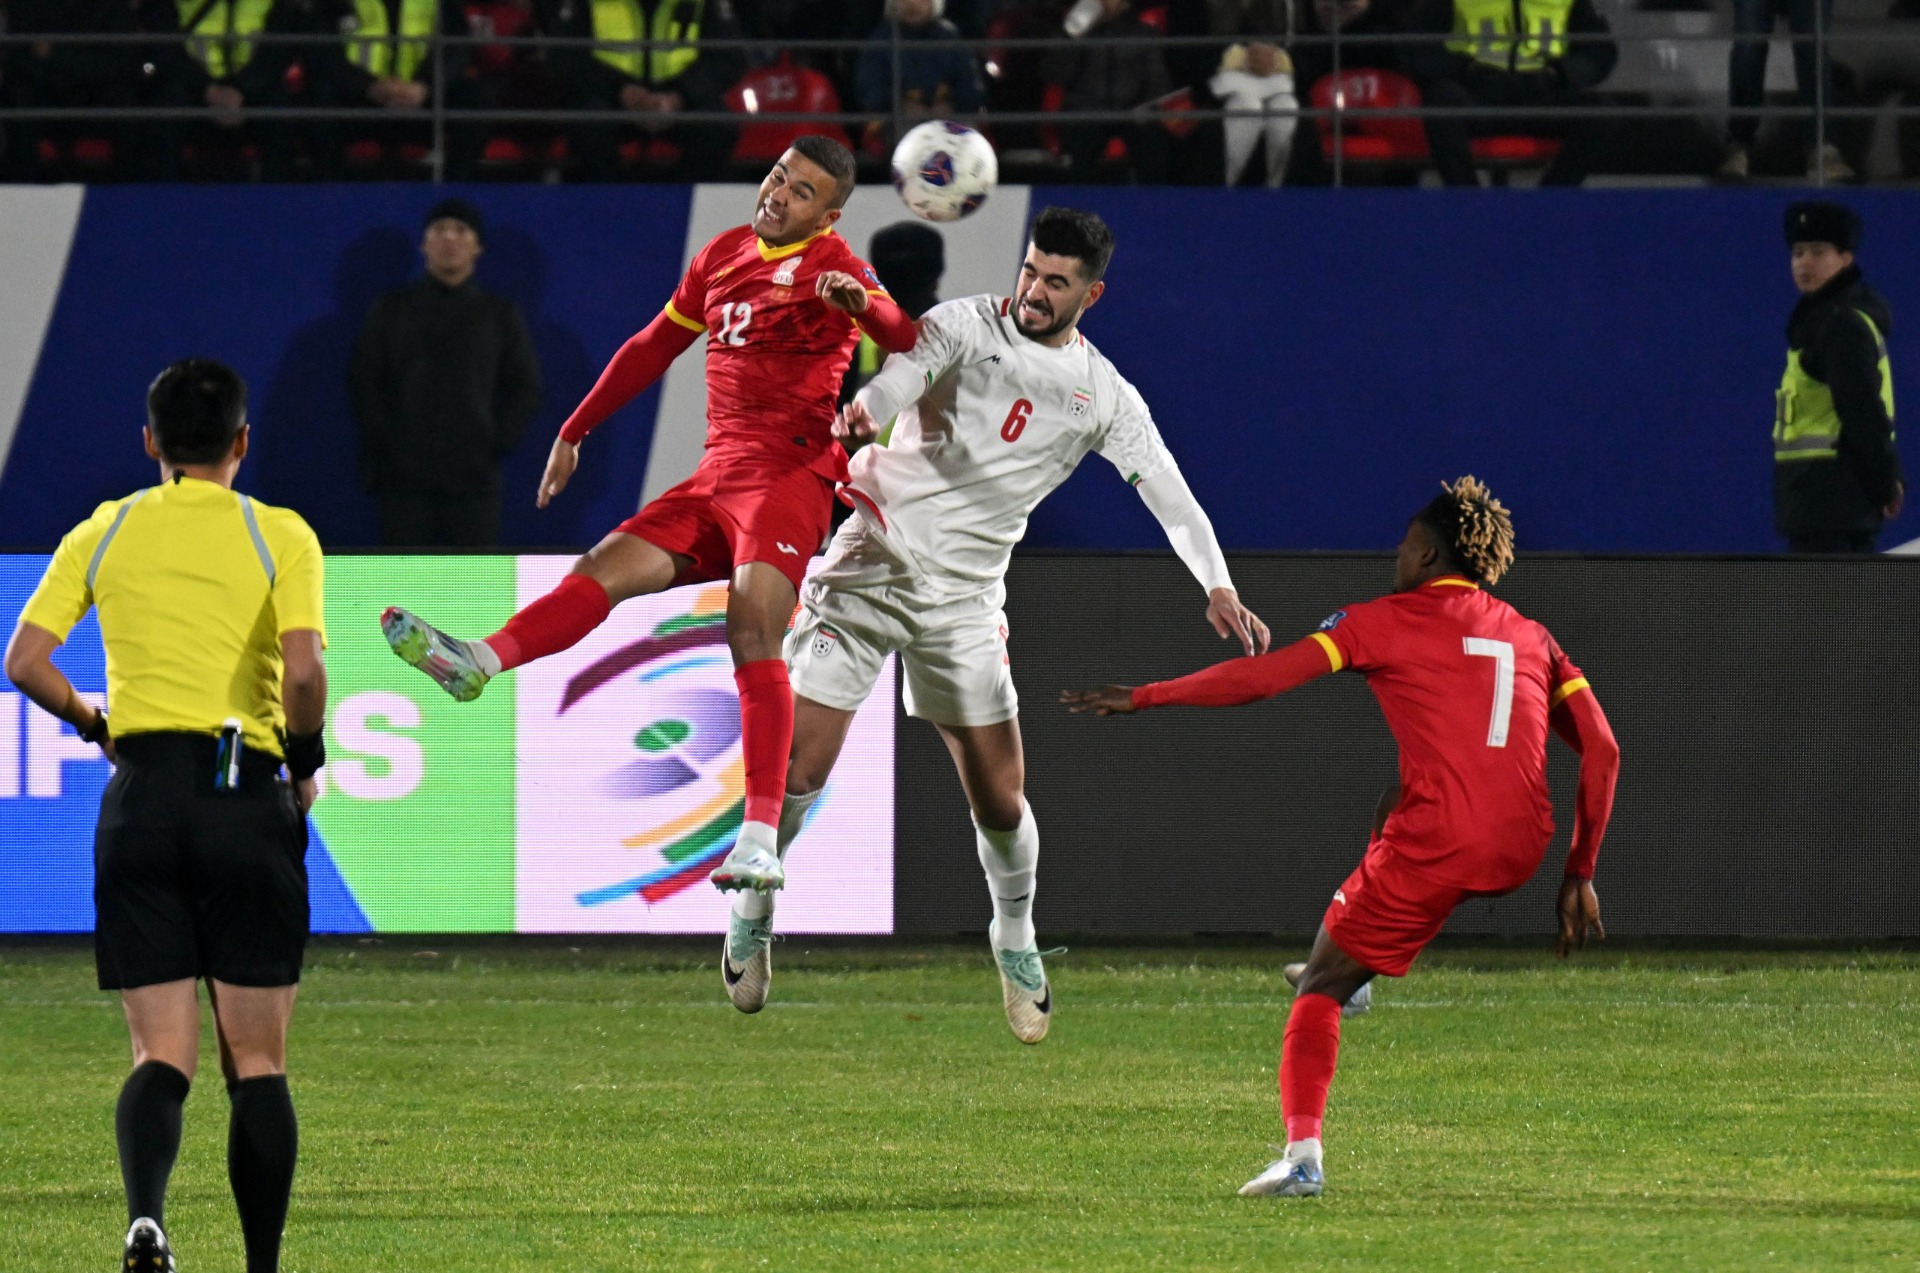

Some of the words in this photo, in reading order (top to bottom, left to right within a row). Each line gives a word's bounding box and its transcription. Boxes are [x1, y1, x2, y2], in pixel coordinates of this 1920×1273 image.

[716, 302, 752, 346] 12
[1001, 398, 1033, 442] 6
[1462, 636, 1514, 748] 7
